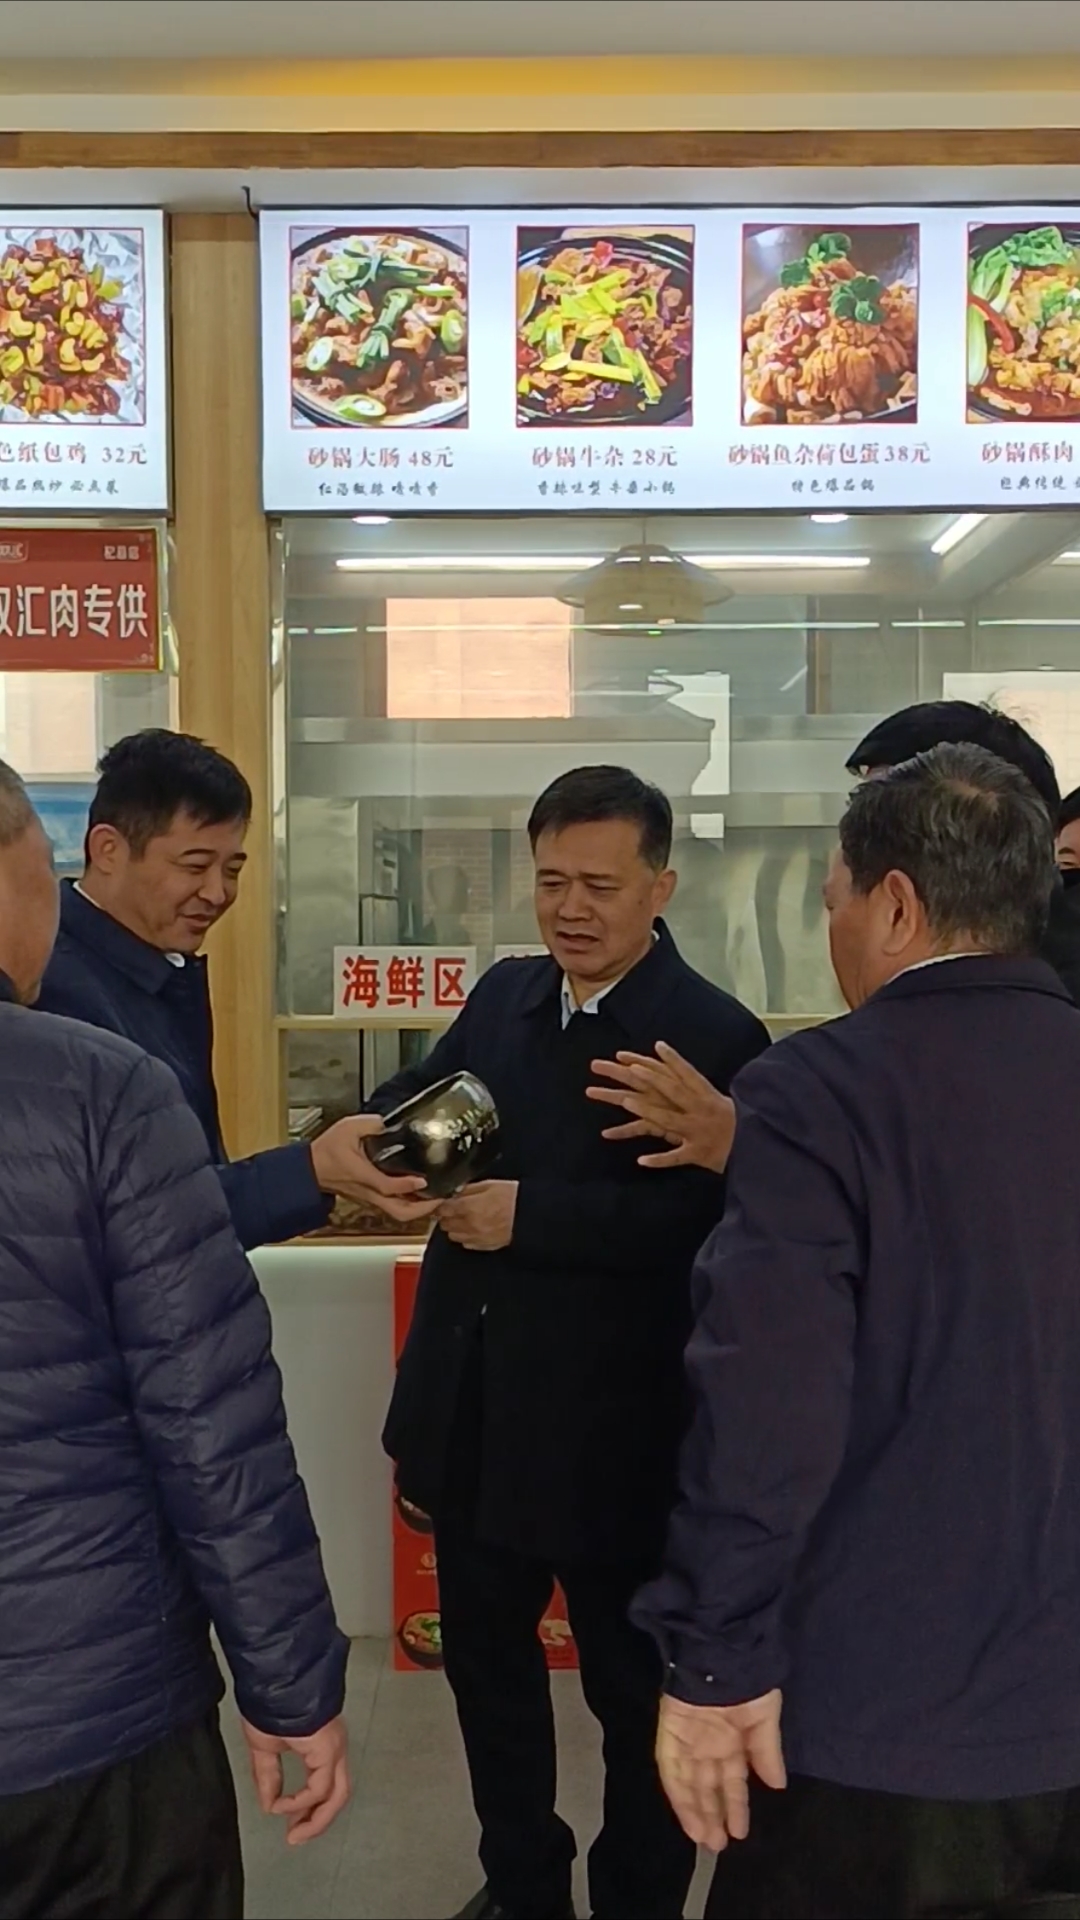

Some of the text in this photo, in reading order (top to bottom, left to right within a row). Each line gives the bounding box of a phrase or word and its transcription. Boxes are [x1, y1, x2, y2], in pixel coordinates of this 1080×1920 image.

[102, 444, 147, 465] 32元
[308, 446, 453, 469] 砂锅大肠 48元
[532, 445, 678, 468] 砂锅牛杂 28元
[728, 442, 930, 466] 砂锅鱼杂荷包蛋 38元
[981, 441, 1073, 464] 砂锅酥肉
[342, 953, 466, 1008] 海鲜区
